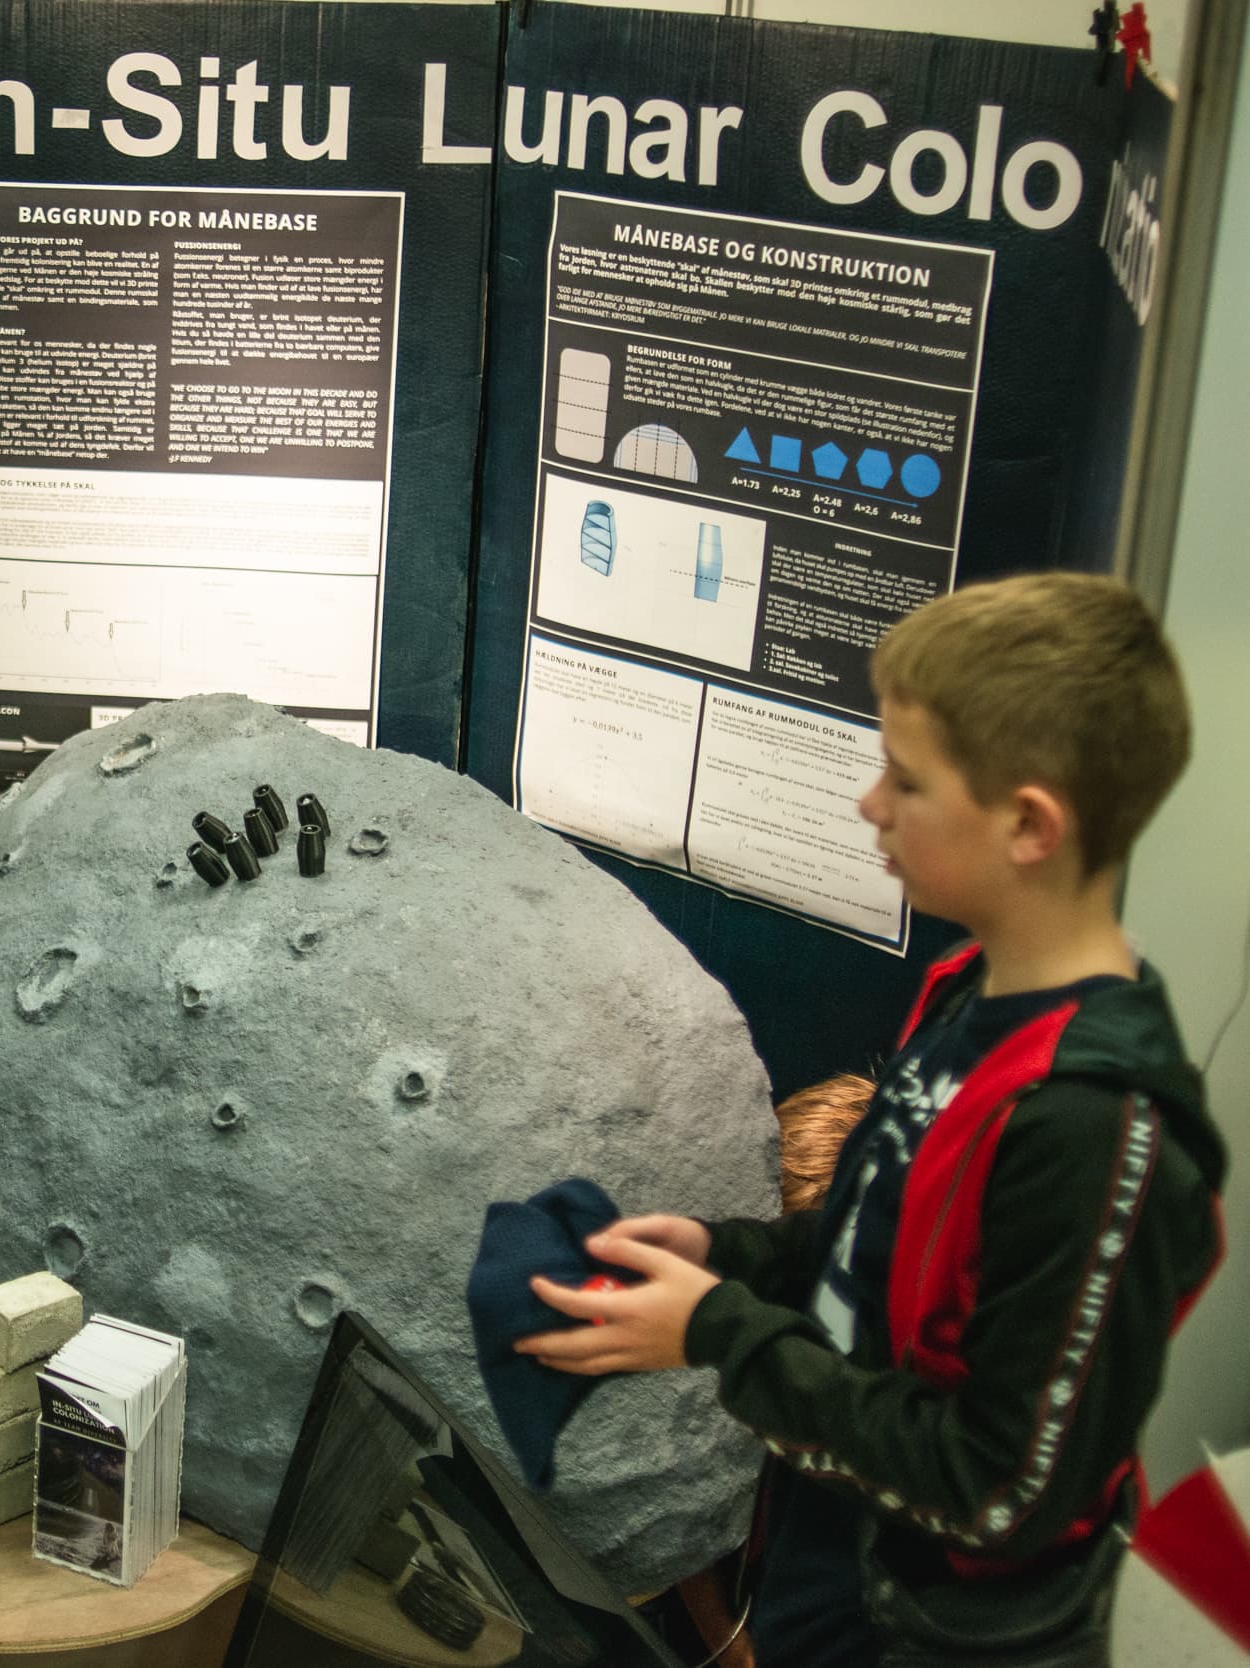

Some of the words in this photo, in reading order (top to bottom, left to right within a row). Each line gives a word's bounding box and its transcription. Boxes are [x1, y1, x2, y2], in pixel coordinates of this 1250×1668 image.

[422, 63, 744, 186] Lunar
[800, 90, 1082, 230] Colo
[18, 206, 141, 226] BAGGRUND
[148, 210, 192, 228] FOR
[198, 208, 317, 232] MÅNEBASE
[120, 251, 146, 259] forhold
[174, 242, 241, 250] FUSSIONSENERGI
[614, 224, 719, 256] MÅNEBASE
[725, 240, 754, 261] OG
[761, 245, 930, 287] KONSTRUKTION
[560, 244, 579, 254] Vores
[580, 247, 607, 261] løsning
[608, 252, 616, 260] er
[617, 254, 627, 262] en
[628, 254, 675, 271] beskyttende
[753, 274, 770, 283] som
[771, 275, 788, 286] skal
[802, 280, 832, 295] printes
[833, 284, 869, 300] omkring
[870, 290, 880, 300] et
[580, 266, 592, 276] for
[635, 274, 643, 283] at
[559, 254, 569, 263] fra
[599, 260, 617, 271] hvor
[671, 271, 687, 281] skal
[735, 280, 774, 296] beskytter
[776, 287, 796, 298] mod
[798, 290, 814, 301] den
[838, 296, 878, 310] kosmiske
[914, 309, 933, 319] som
[954, 313, 971, 324] det
[628, 345, 686, 362] BEGRUNDELSE
[688, 355, 704, 365] FOR
[706, 358, 732, 370] FORM
[241, 386, 251, 394] TO
[252, 387, 266, 395] THE
[365, 390, 378, 398] DO
[0, 479, 12, 487] OG
[15, 480, 56, 488] TYKKELSE
[73, 482, 95, 490] SKAL
[535, 651, 574, 667] HÆLDNING
[576, 660, 586, 670] PÅ
[588, 665, 617, 678] VÆGGE
[712, 697, 753, 715] RUMFANG
[755, 708, 765, 718] AF
[768, 712, 819, 733] RUMMODUL
[822, 726, 834, 737] OG
[836, 730, 858, 744] SKAL
[1113, 1120, 1153, 1217] NIFTY
[1063, 1272, 1110, 1365] NIFTY
[52, 1399, 82, 1415] IN-SITU
[53, 1407, 115, 1434] COLONIZATION
[1015, 1421, 1064, 1503] NIFTY
